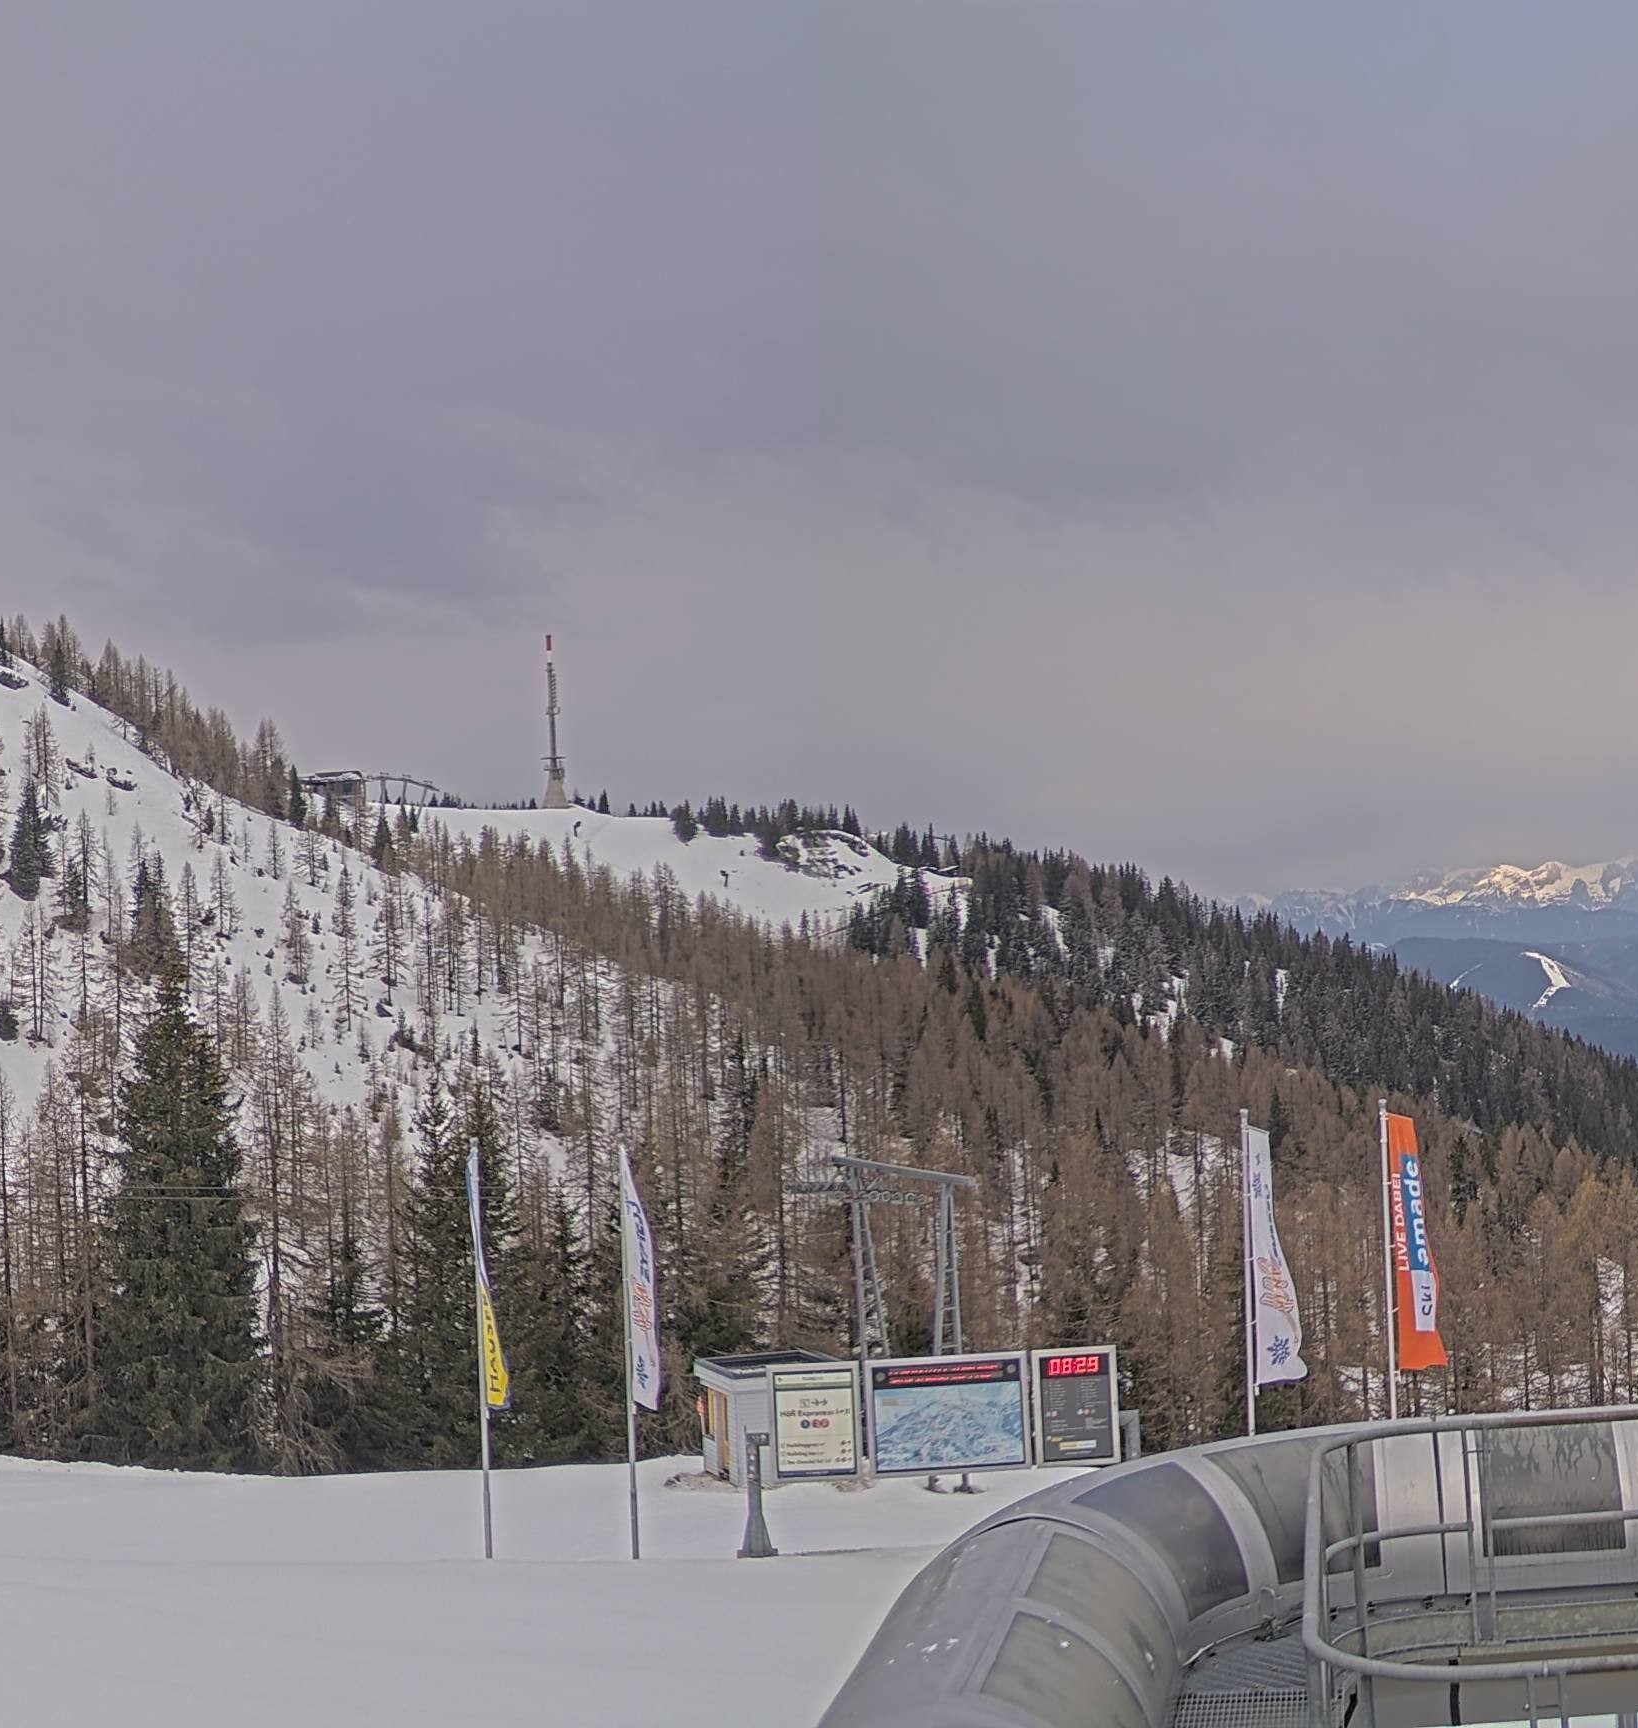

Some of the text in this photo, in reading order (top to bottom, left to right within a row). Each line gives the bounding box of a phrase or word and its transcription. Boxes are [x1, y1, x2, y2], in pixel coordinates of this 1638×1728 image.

[1392, 1173, 1410, 1272] LIVE DABEI
[1421, 1286, 1434, 1316] Ski
[1048, 1356, 1099, 1376] 08:29
